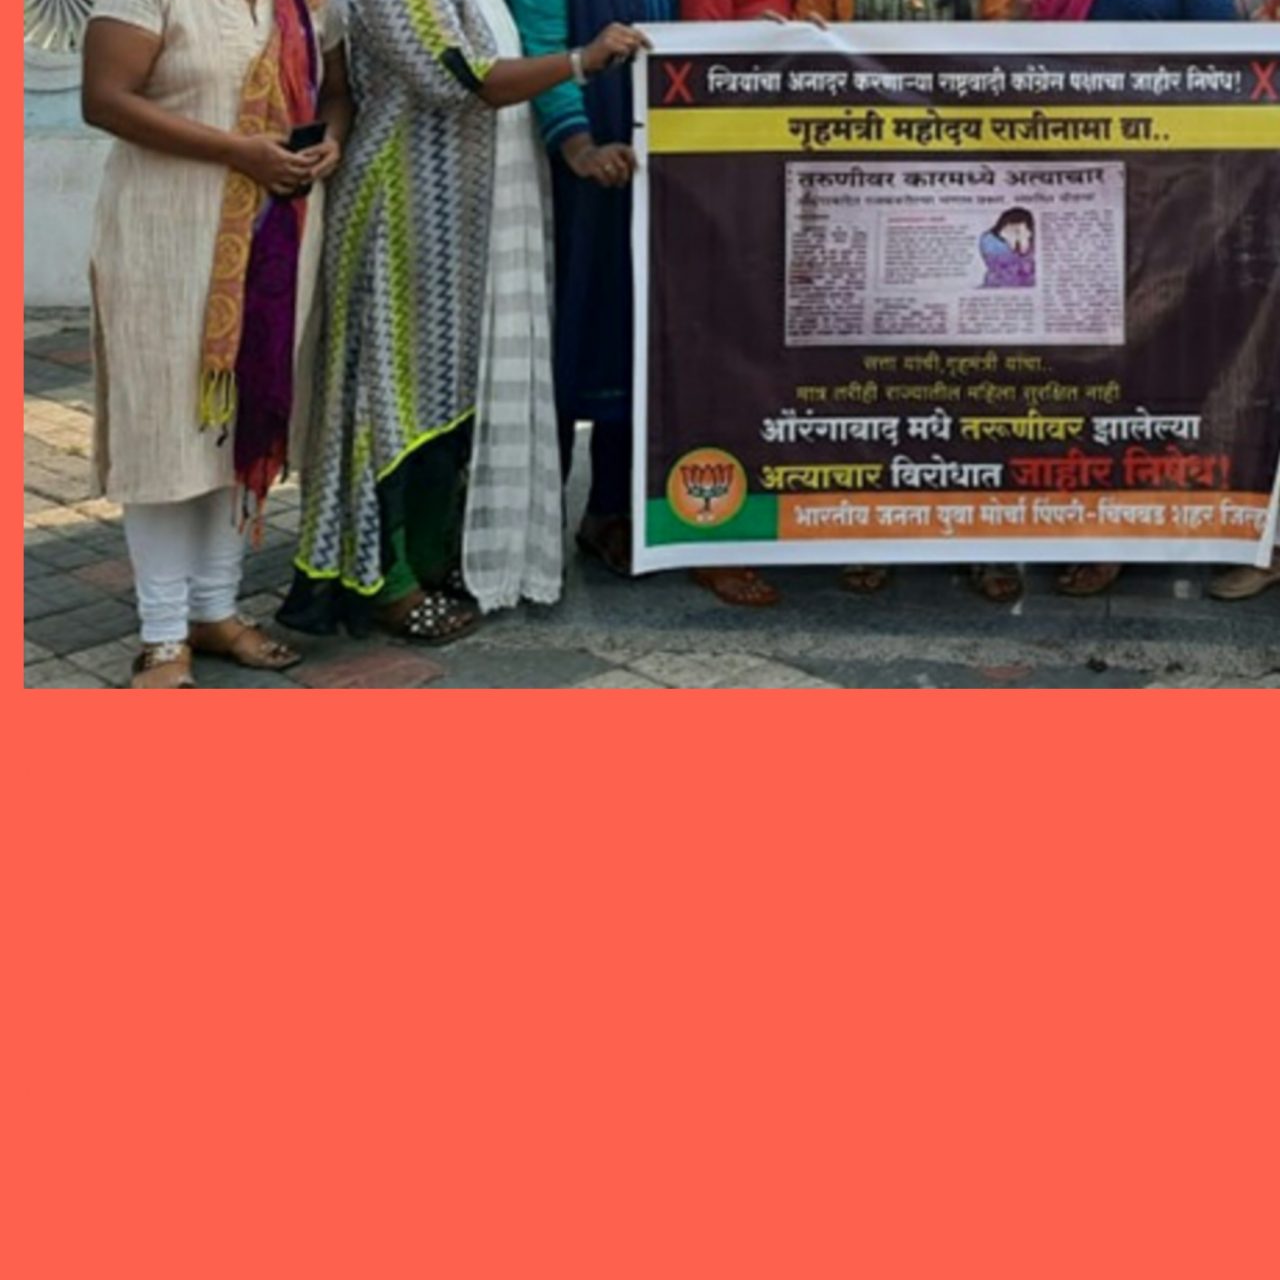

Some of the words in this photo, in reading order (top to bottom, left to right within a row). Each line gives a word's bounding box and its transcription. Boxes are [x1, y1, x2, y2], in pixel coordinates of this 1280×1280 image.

[1130, 65, 1182, 95] जाहीर
[788, 110, 884, 150] गृहमंत्री
[892, 108, 981, 144] महोदय
[990, 110, 1111, 141] राजीनामा
[1092, 407, 1201, 443] झालेल्या
[760, 463, 883, 490] अत्याचार
[891, 454, 1002, 489] विरोधात
[1009, 447, 1113, 492] जाहीर
